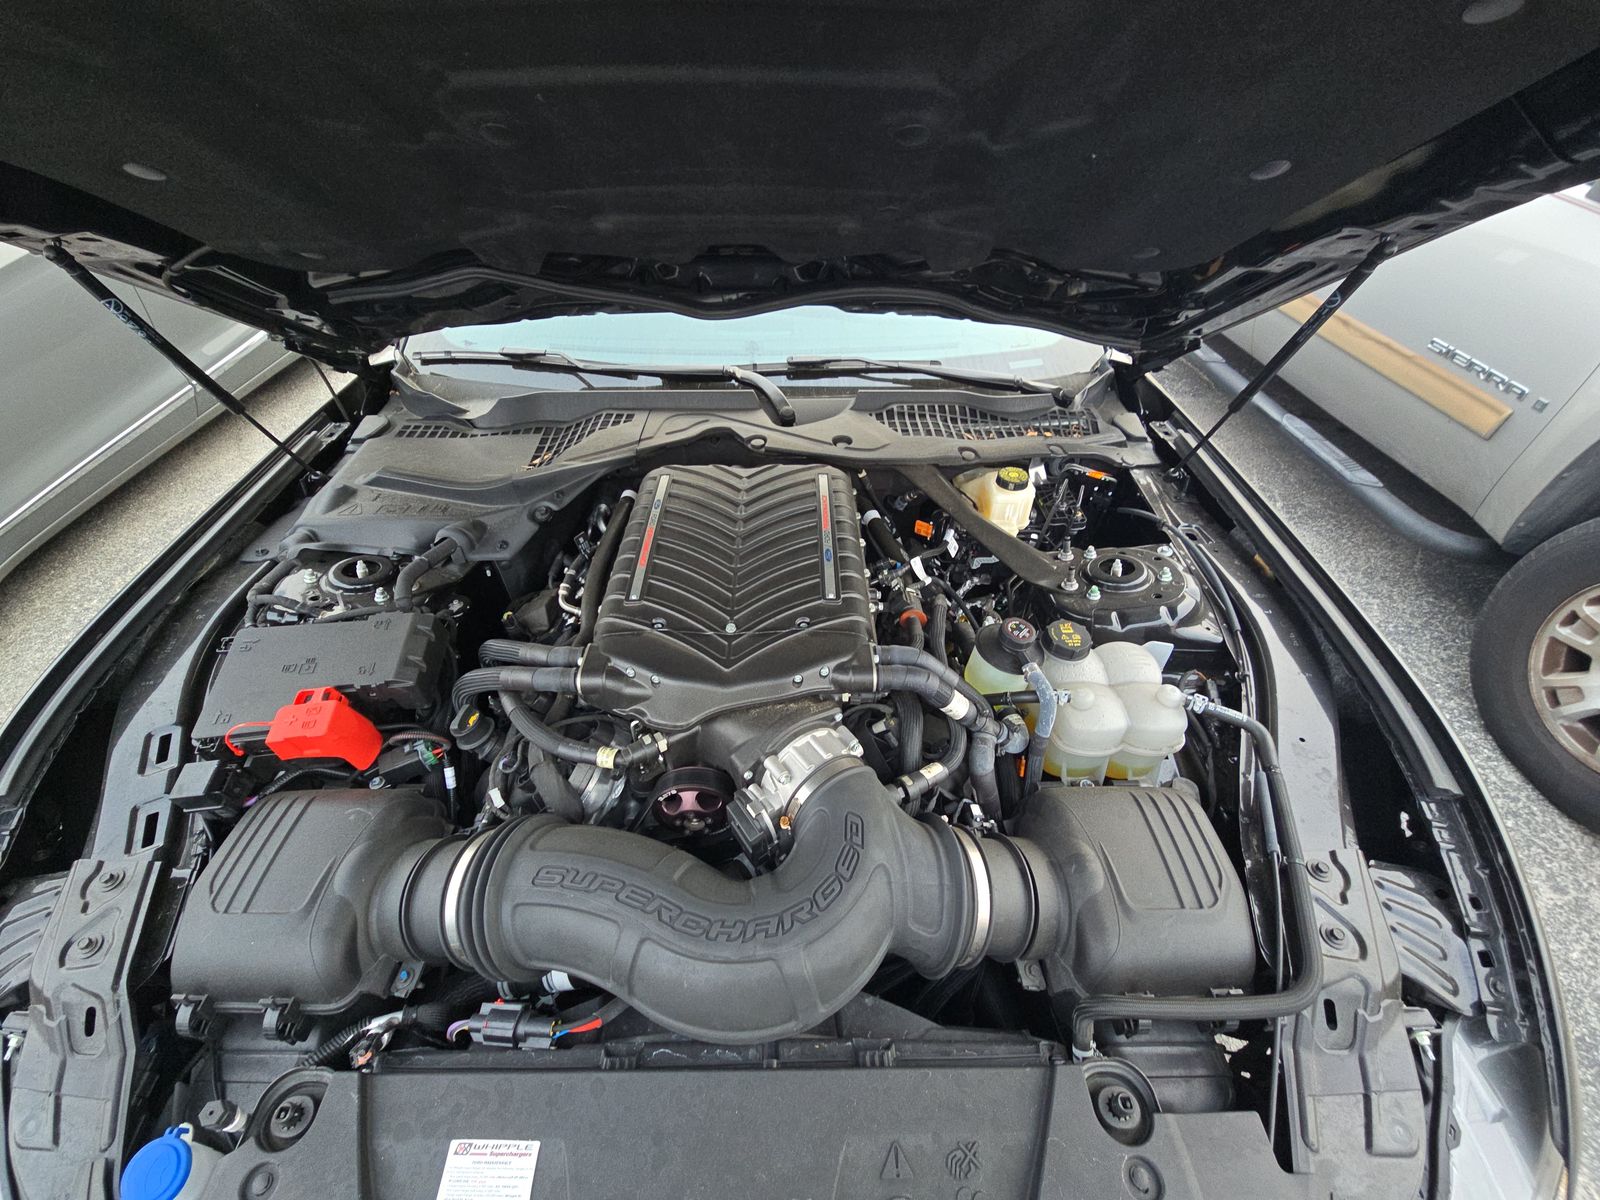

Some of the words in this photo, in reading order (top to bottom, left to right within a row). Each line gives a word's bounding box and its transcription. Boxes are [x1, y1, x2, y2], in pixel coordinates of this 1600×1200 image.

[1427, 337, 1529, 400] SIERRA
[532, 811, 865, 943] SUPERCHARGED
[473, 1143, 534, 1151] WHIPPLE
